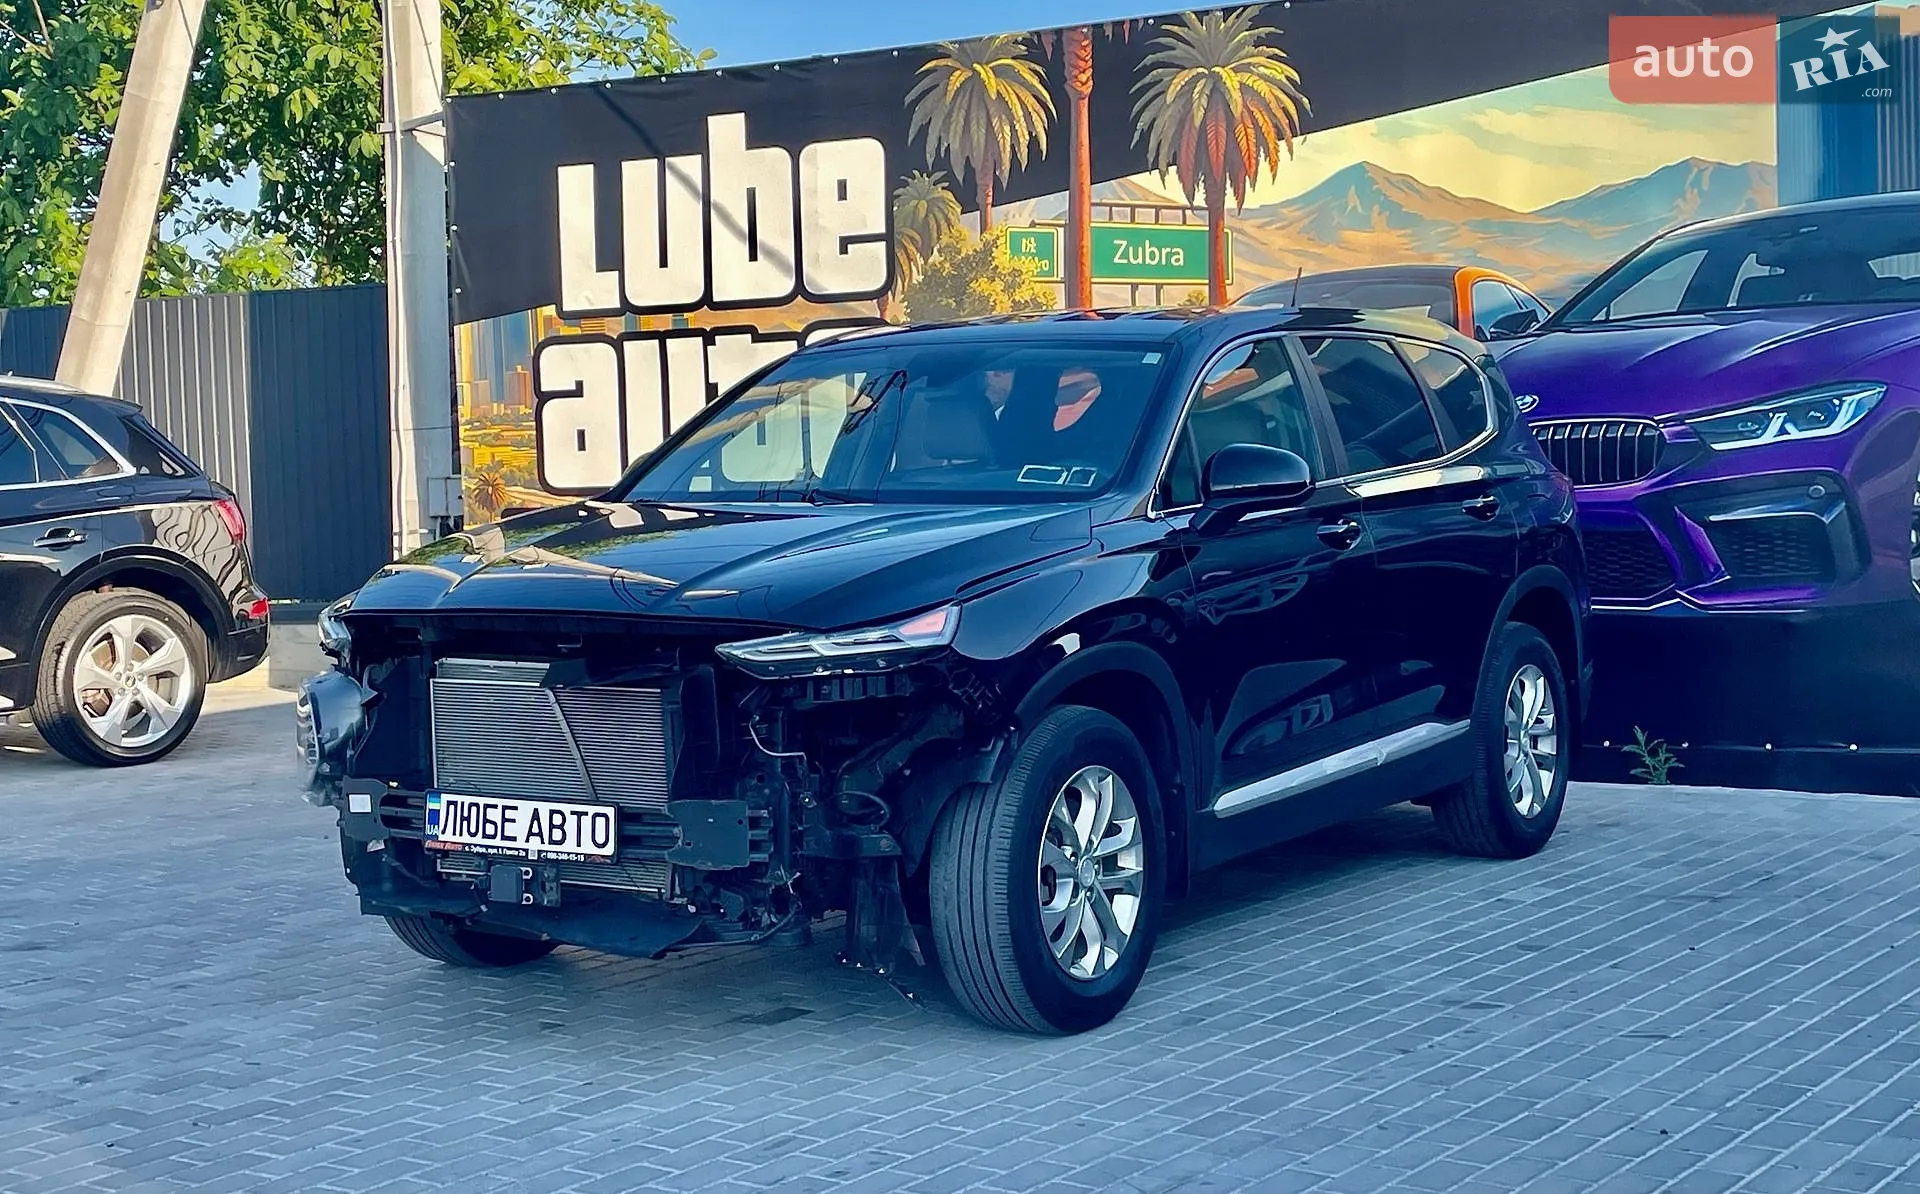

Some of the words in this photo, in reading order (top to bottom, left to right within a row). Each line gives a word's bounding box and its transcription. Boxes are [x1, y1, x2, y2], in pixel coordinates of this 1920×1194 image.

[1113, 239, 1185, 267] Zubra
[426, 824, 439, 836] UA
[440, 799, 519, 843] ЛЮБЕ
[524, 807, 611, 849] АВТО
